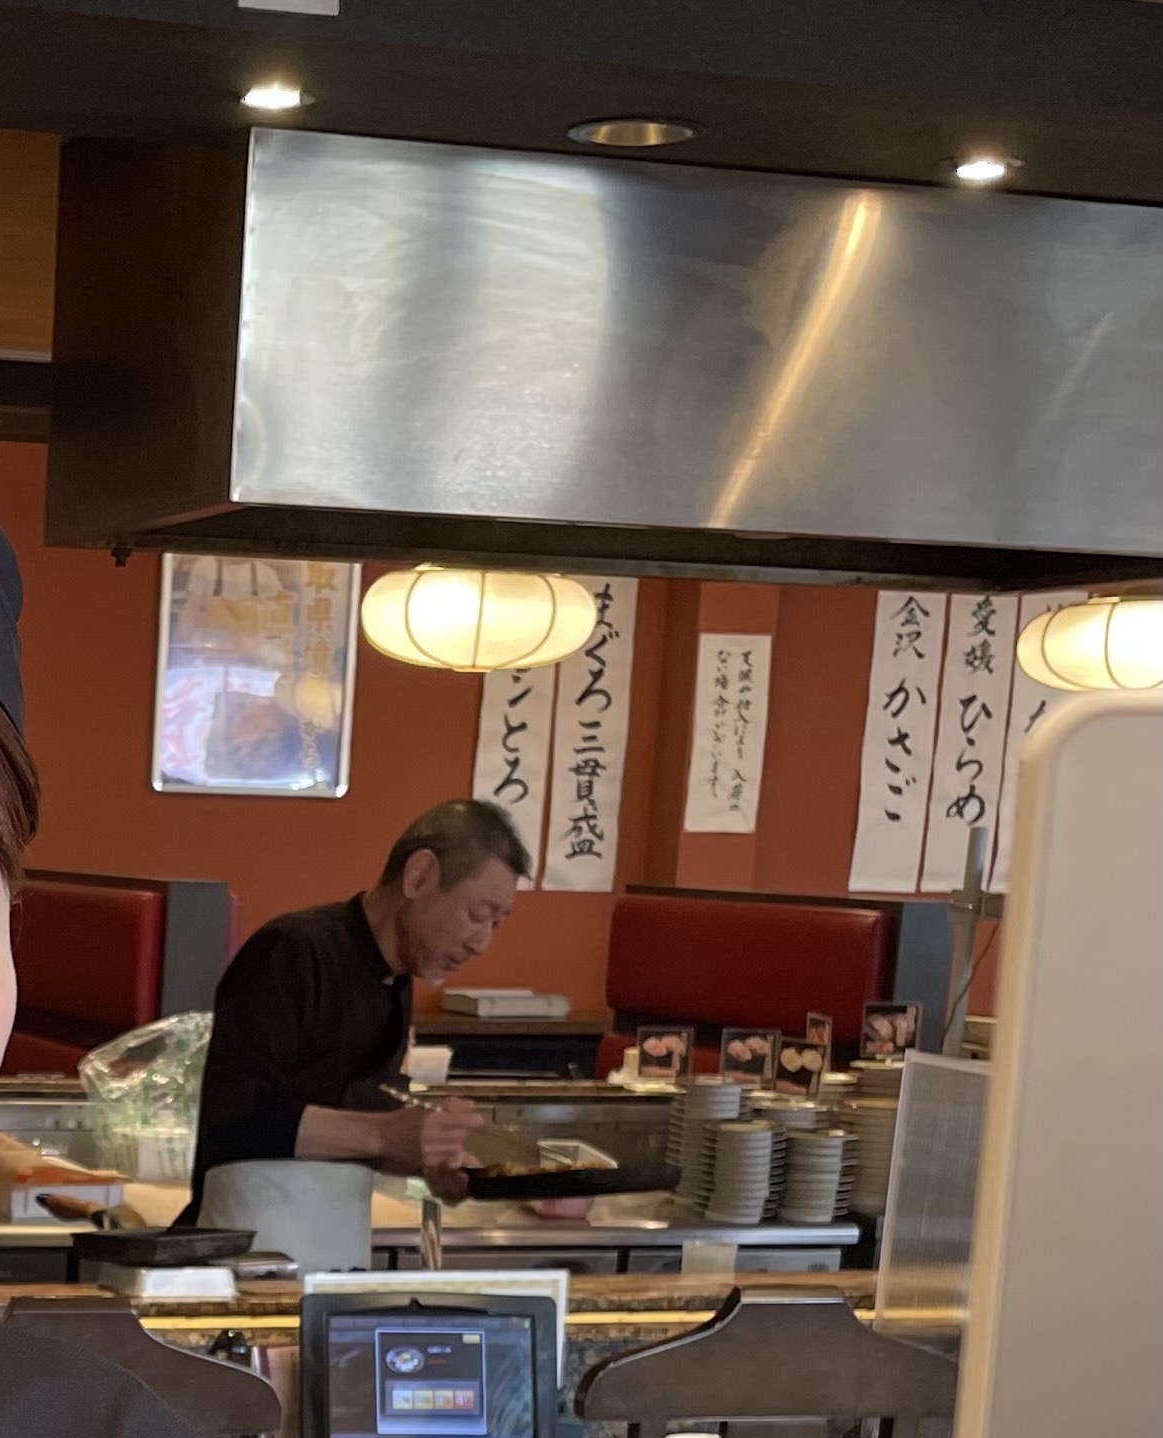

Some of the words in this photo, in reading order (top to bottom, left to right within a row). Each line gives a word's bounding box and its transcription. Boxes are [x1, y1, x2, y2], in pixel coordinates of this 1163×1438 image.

[889, 596, 930, 659] 金沢
[493, 668, 534, 805] ンとろ
[883, 678, 927, 822] かさご
[946, 695, 993, 826] ひらめ
